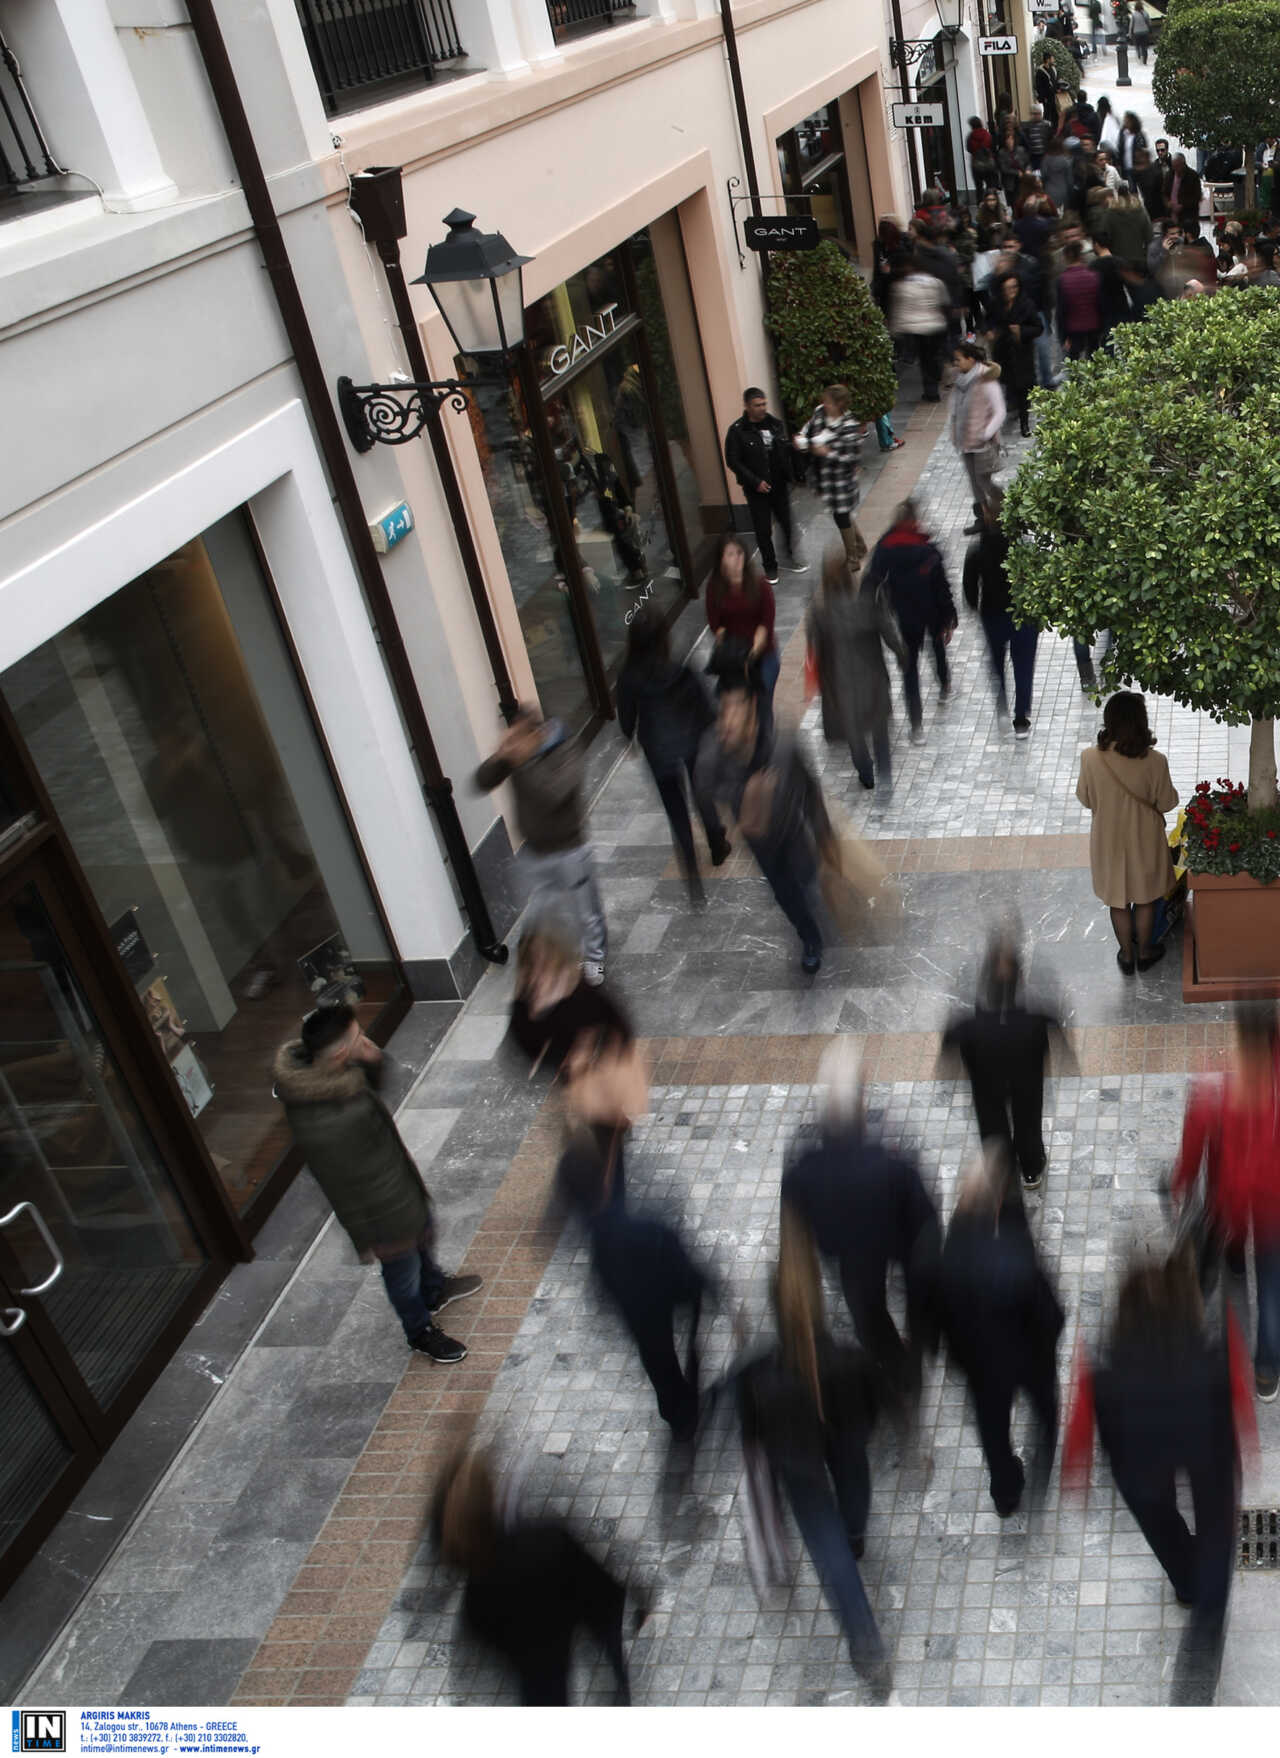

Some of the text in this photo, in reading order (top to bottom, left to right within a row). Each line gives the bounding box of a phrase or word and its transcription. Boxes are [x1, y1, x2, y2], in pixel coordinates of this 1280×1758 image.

[983, 41, 1012, 51] FILA
[754, 227, 808, 236] GANT
[550, 302, 619, 375] GANT
[624, 579, 654, 625] GANT
